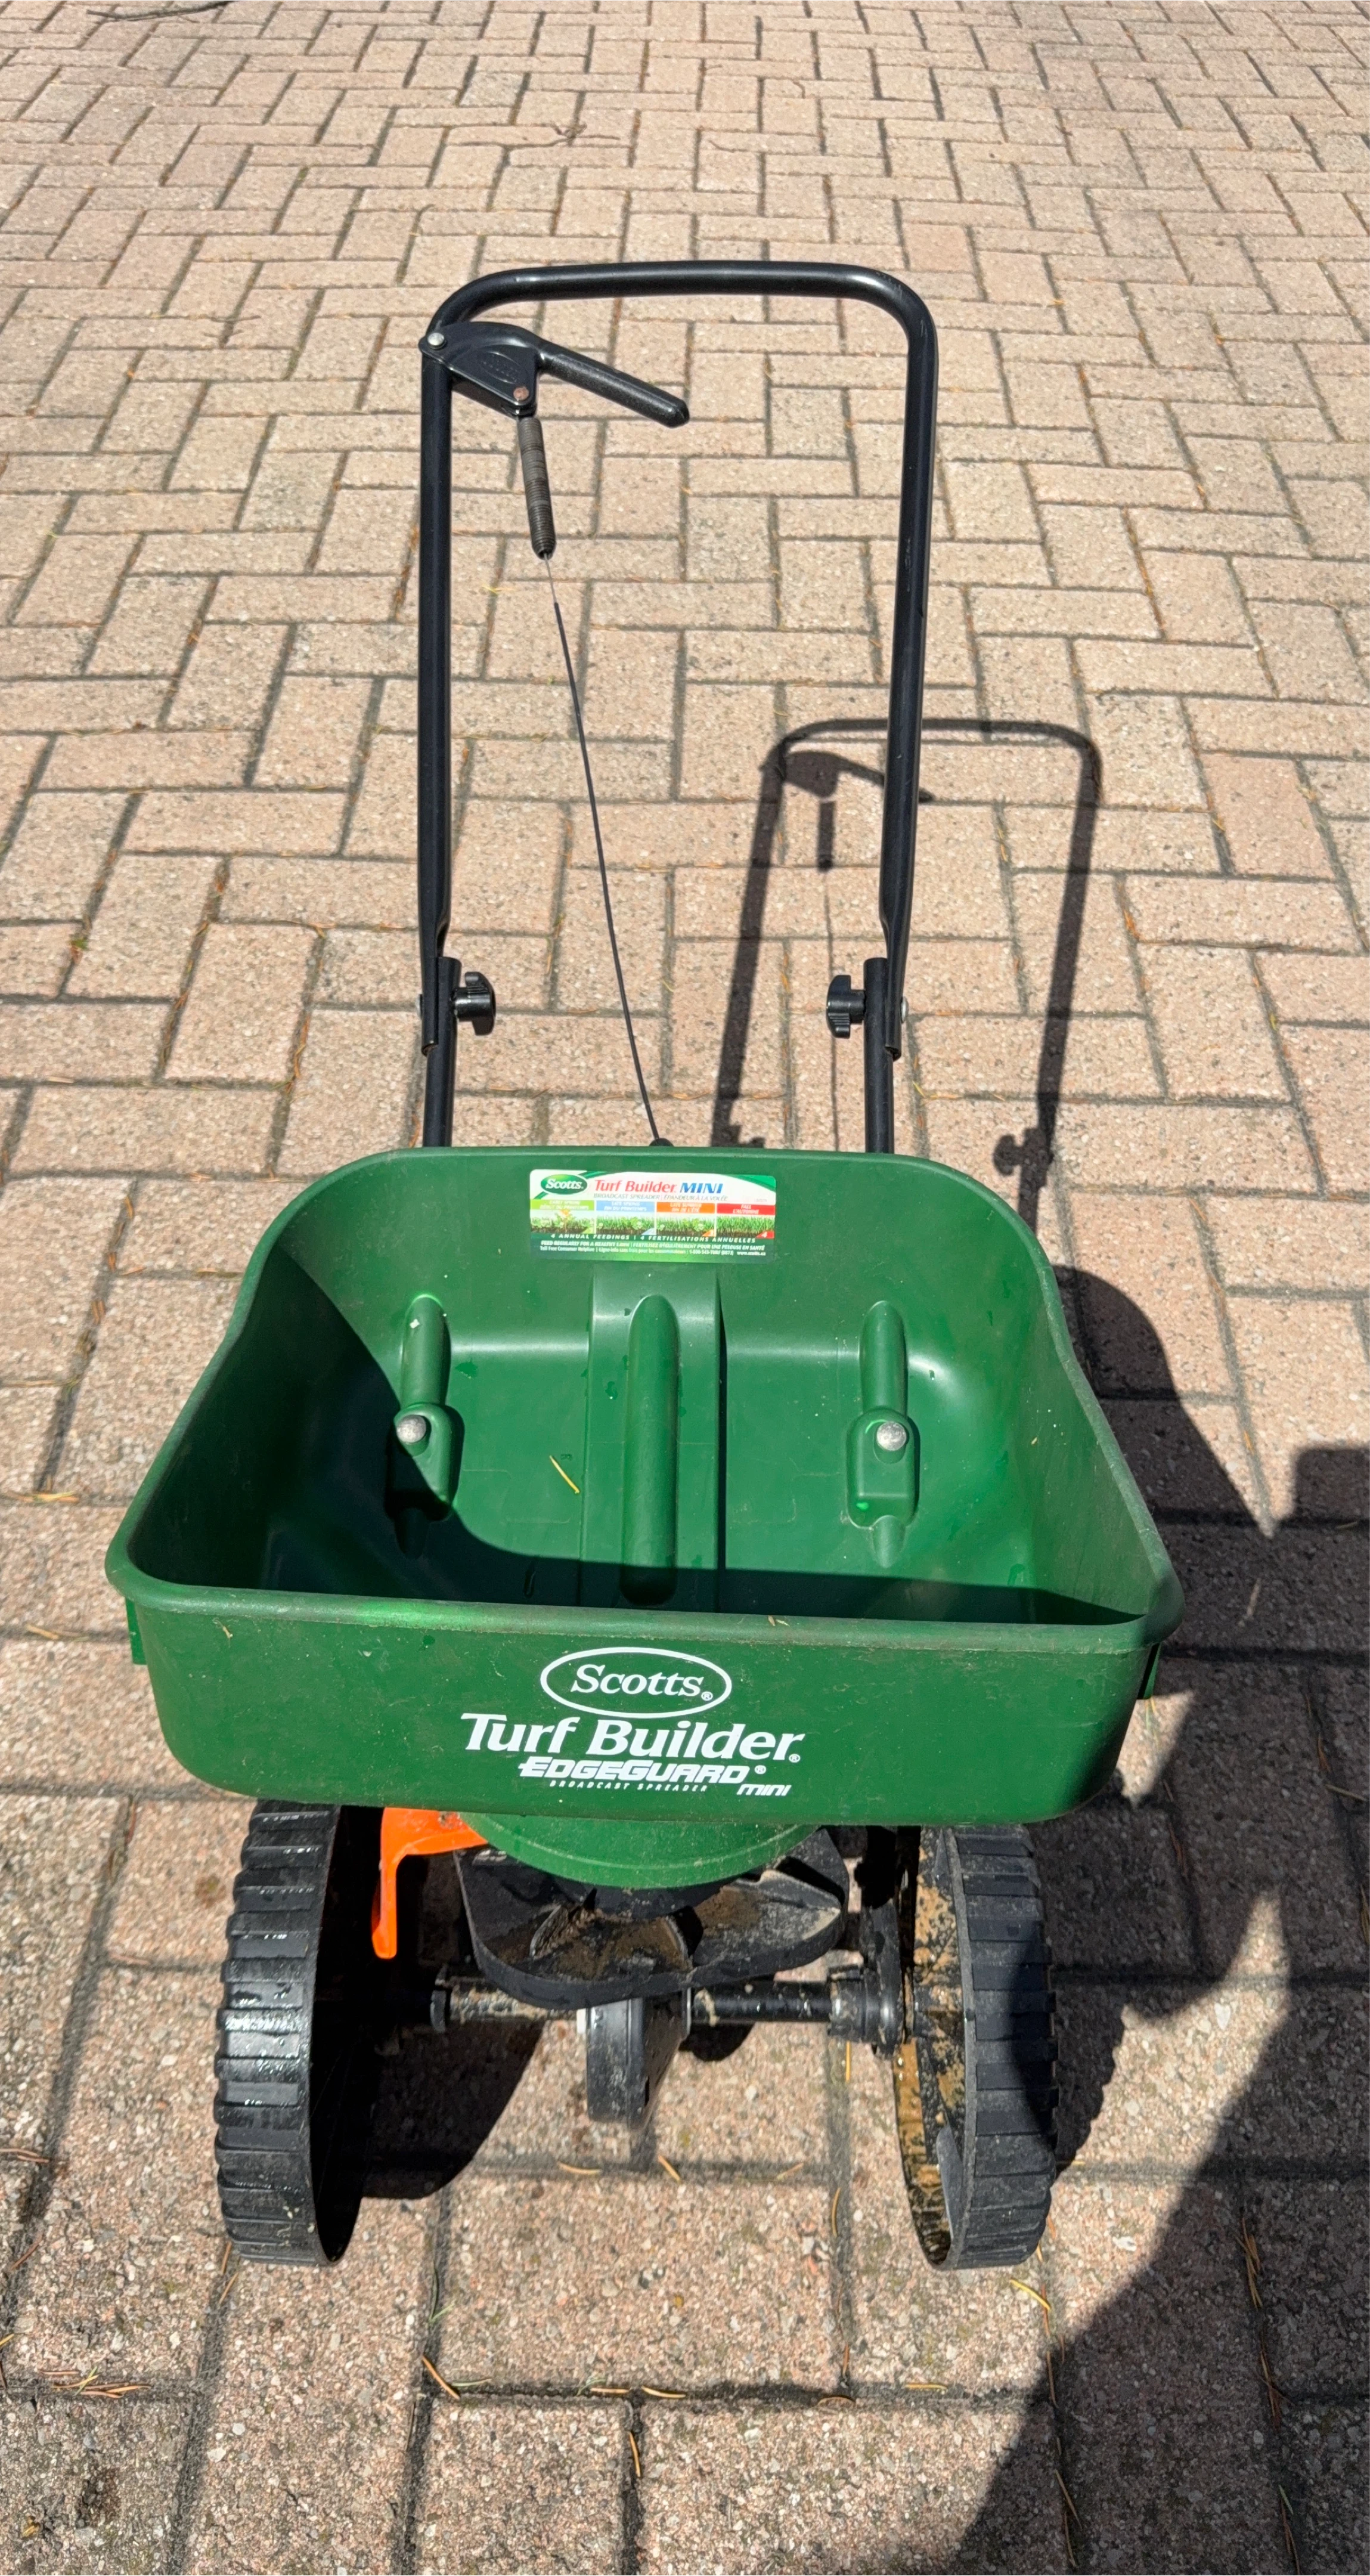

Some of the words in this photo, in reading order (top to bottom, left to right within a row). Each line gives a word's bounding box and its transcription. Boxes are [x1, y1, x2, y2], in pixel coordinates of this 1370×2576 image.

[545, 1178, 583, 1190] Scotts
[594, 1179, 622, 1192] Turf
[624, 1181, 677, 1193] Builder
[680, 1182, 724, 1194] MINI
[571, 1664, 704, 1697] Scotts
[460, 1713, 581, 1754] Turf
[585, 1719, 805, 1760] Builder
[550, 1780, 630, 1790] BROADCAST
[637, 1783, 708, 1792] SPREADER
